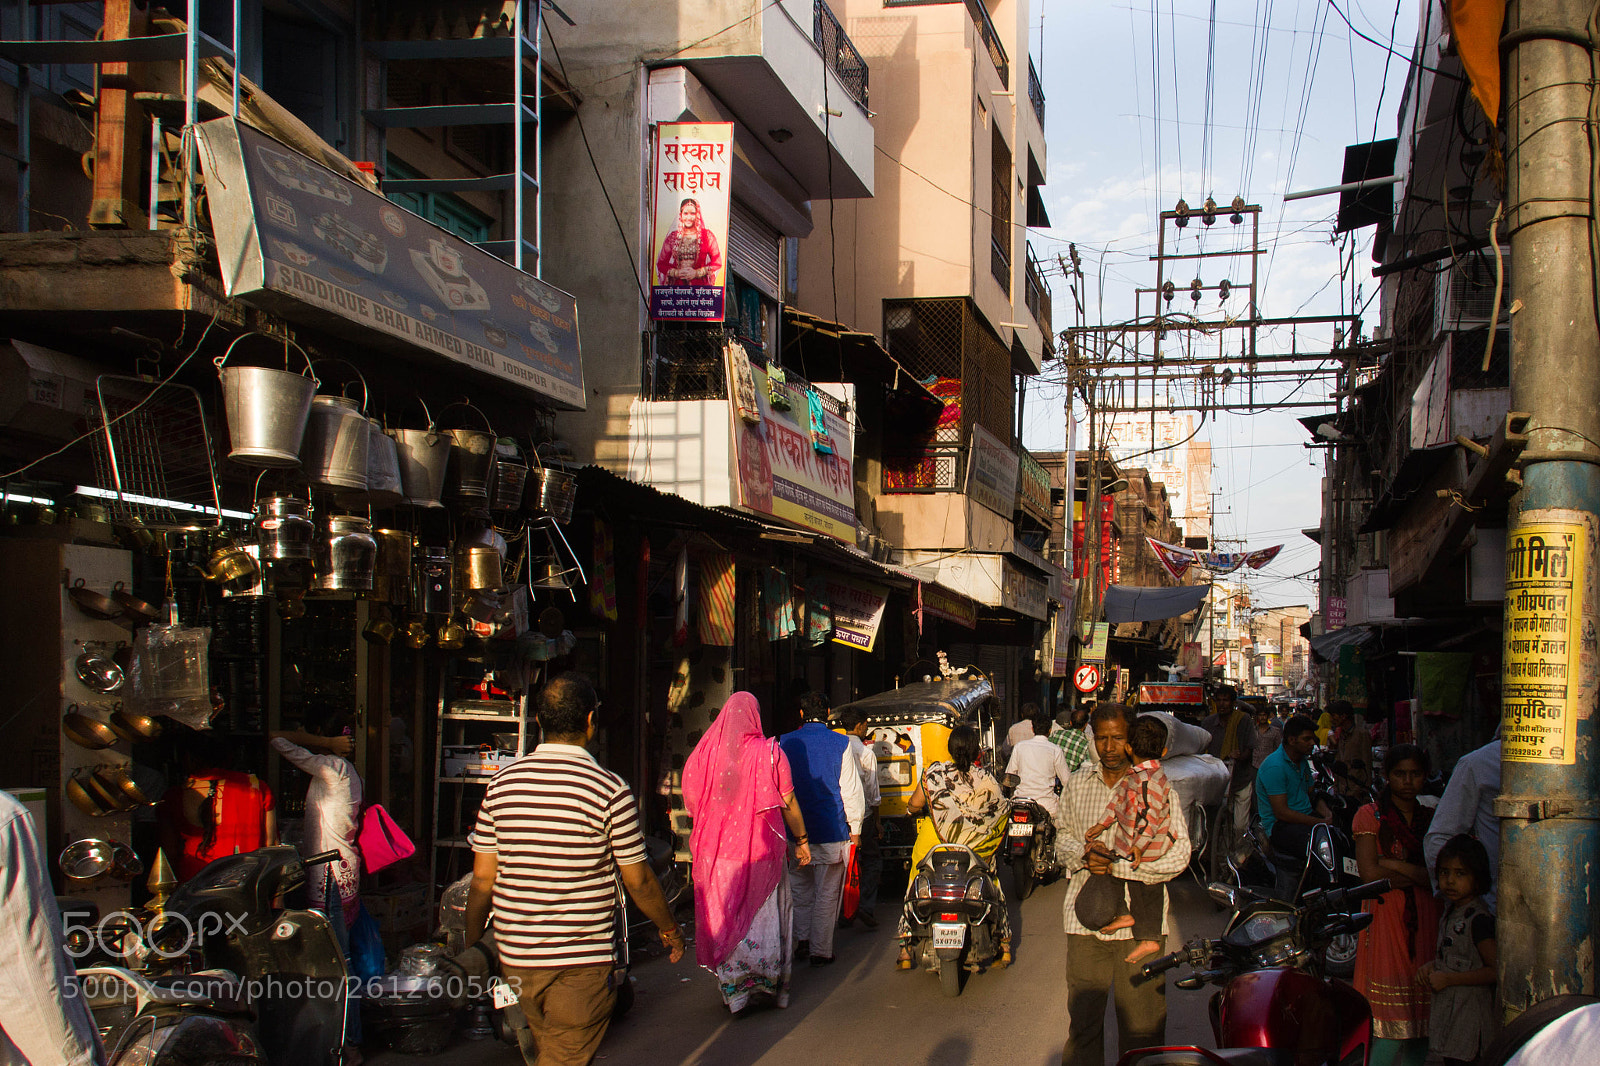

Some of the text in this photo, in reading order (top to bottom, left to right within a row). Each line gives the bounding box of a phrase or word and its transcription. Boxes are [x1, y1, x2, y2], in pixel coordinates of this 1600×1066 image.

[664, 136, 725, 163] संस्कार
[663, 165, 722, 193] साड़ीज
[279, 265, 368, 317] SADDIQUE
[374, 302, 410, 335] BHAI
[415, 319, 462, 355] AHMED
[466, 340, 496, 369] BHAI
[763, 407, 815, 481] संस्कार
[1528, 535, 1573, 578] मिलें
[1529, 613, 1539, 632] की
[835, 629, 870, 645] ऊपर पधारें
[1512, 635, 1567, 654] पेशाब में जलन
[1539, 658, 1567, 678] निकलना
[1505, 699, 1562, 723] आयुर्वेदिक
